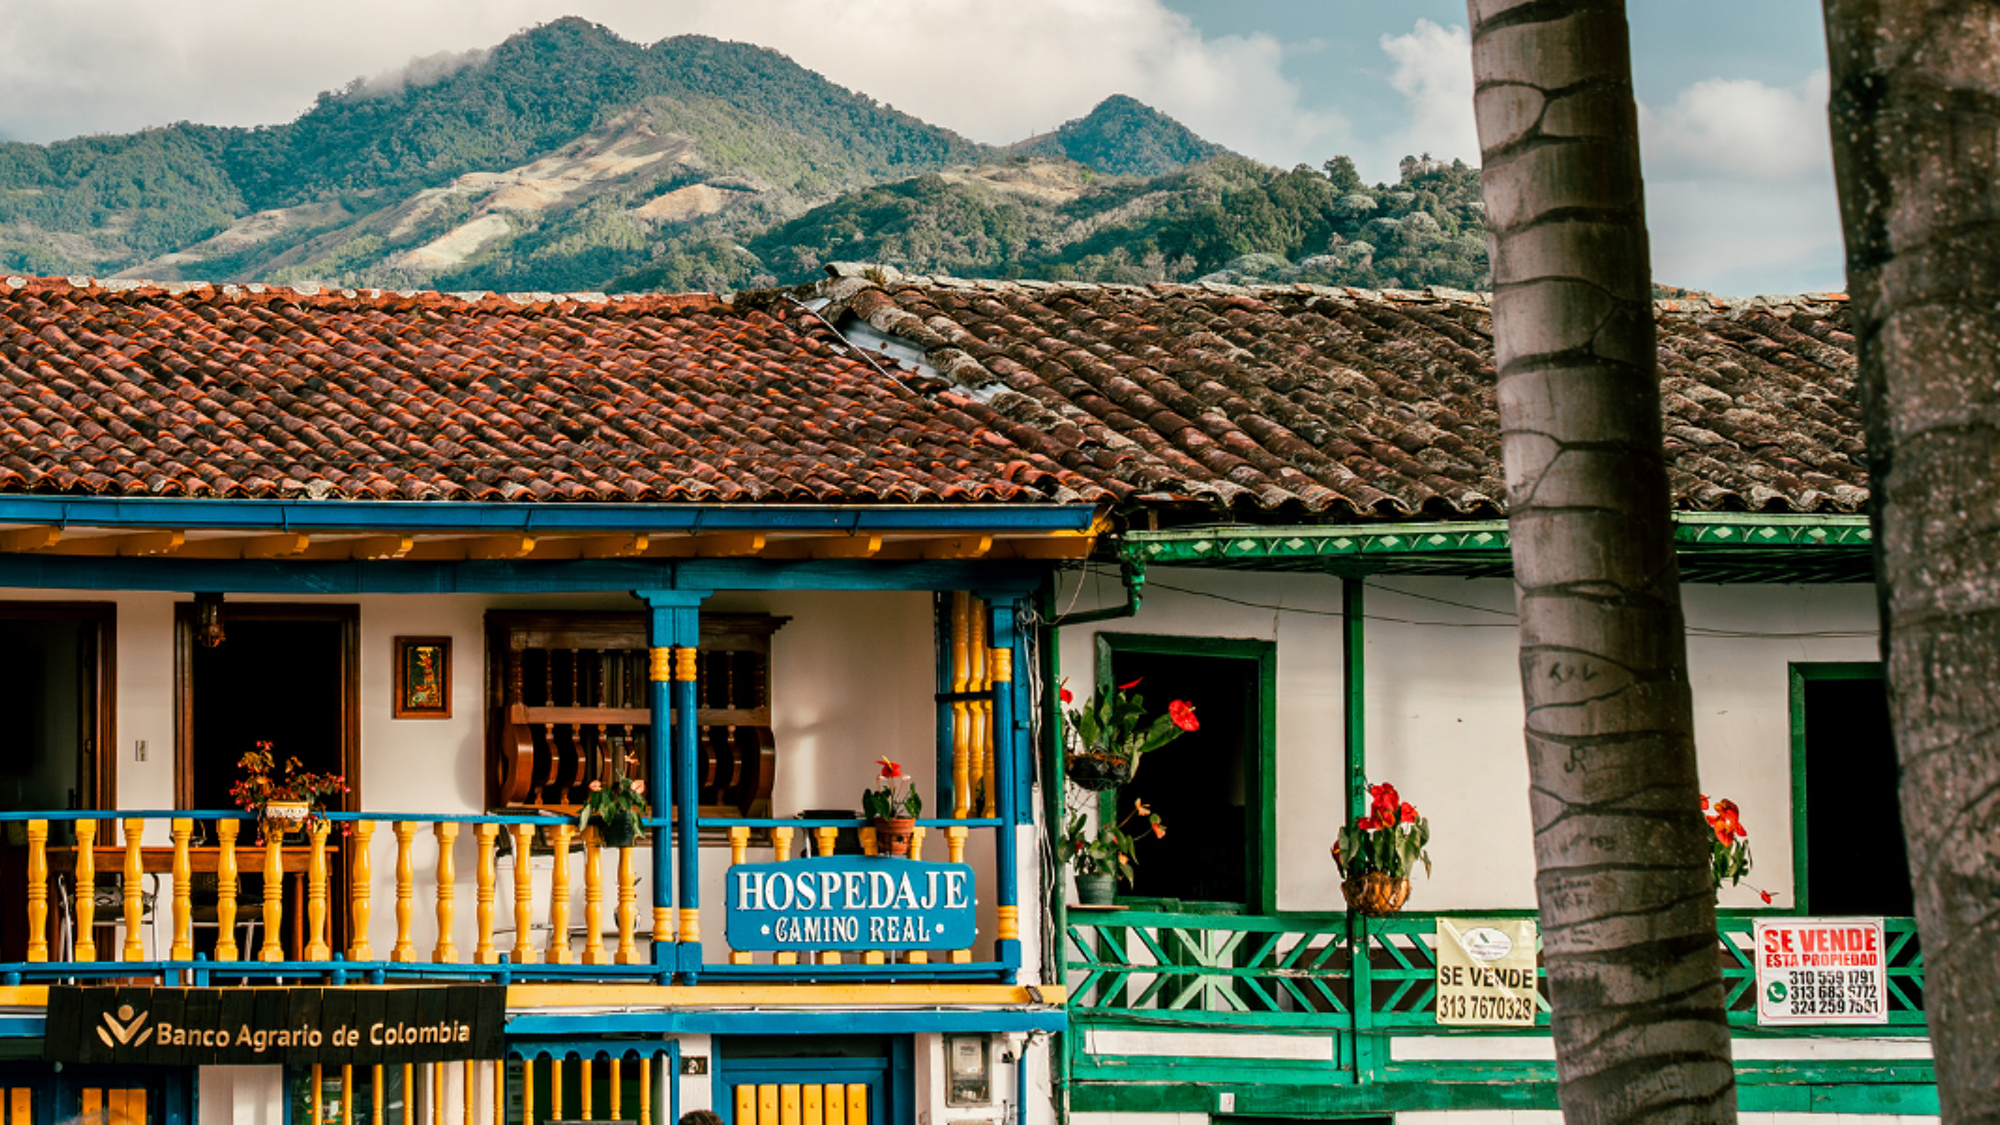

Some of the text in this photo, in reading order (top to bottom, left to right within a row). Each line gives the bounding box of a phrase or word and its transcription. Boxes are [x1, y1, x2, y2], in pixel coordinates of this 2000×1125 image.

[736, 871, 968, 911] HOSPEDAJE
[775, 916, 930, 943] CAMINO REAL
[1763, 928, 1877, 953] SE VENDE
[1765, 953, 1878, 968] ESTA PROPIEDAD
[1440, 965, 1533, 989] SE VENDE
[1789, 969, 1875, 985] 310 559 1791
[1790, 985, 1815, 1000] 313
[1440, 995, 1532, 1020] 313 7670328
[1790, 1000, 1816, 1015] 324
[1819, 1000, 1846, 1014] 259
[157, 1020, 471, 1053] Banco Agrario de Colombia
